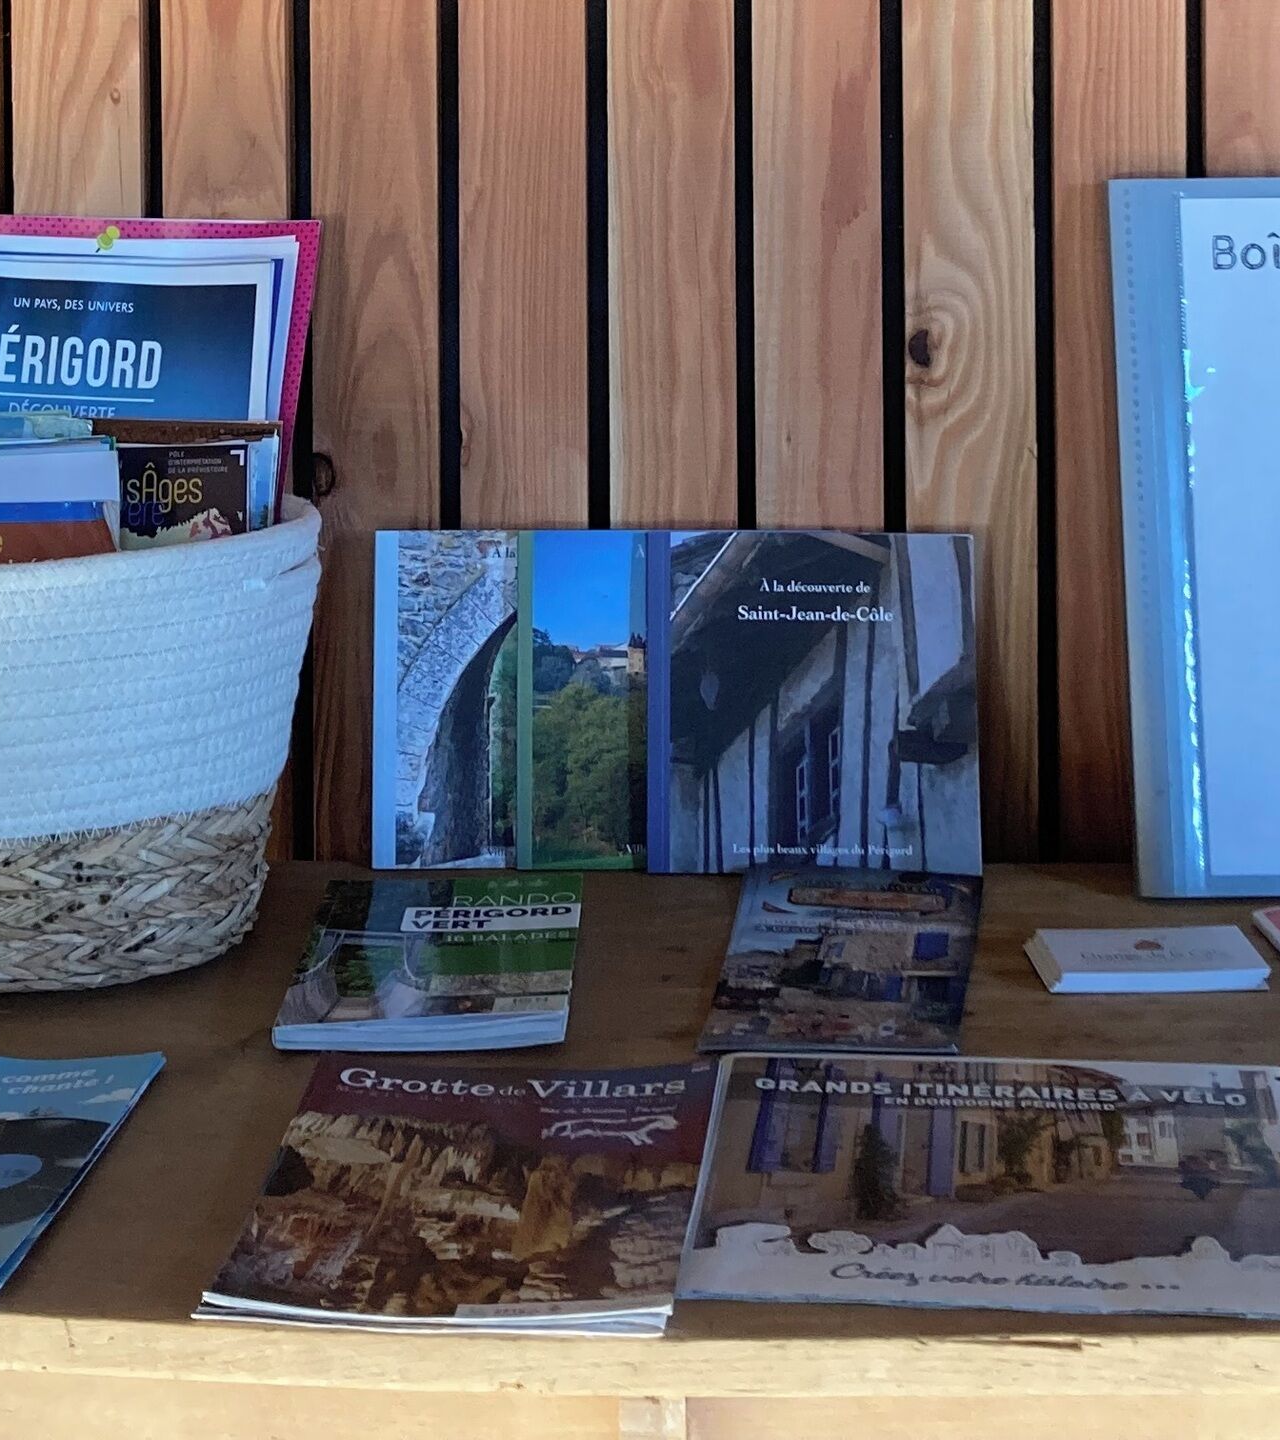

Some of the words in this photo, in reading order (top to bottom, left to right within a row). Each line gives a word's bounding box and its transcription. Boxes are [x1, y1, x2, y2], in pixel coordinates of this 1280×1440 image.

[13, 297, 31, 309] UN
[33, 298, 61, 312] PAYS,
[64, 299, 84, 310] DES
[88, 300, 134, 313] UNIVERS
[759, 577, 770, 592] À
[773, 580, 785, 592] la
[787, 580, 853, 593] découverte
[855, 581, 870, 593] de
[737, 604, 894, 622] Saint-Jean-de-Côle
[777, 843, 808, 855] beaux
[453, 892, 576, 907] RANDO
[414, 904, 572, 919] PÉRIGORD
[412, 920, 492, 929] VERT
[1, 1069, 97, 1085] comme
[340, 1067, 495, 1097] Grotte
[499, 1085, 525, 1097] de
[527, 1078, 687, 1100] Villars
[7, 1078, 100, 1095] chante
[754, 1078, 893, 1095] GRANDS
[902, 1082, 1119, 1102] ITINÉRAIRES
[1159, 1084, 1247, 1107] VÉLO
[884, 1097, 909, 1106] EN
[914, 1097, 1016, 1109] DORDOGNE
[830, 1262, 922, 1287] Créez
[928, 1271, 1010, 1286] votre
[1015, 1272, 1129, 1291] histoire
